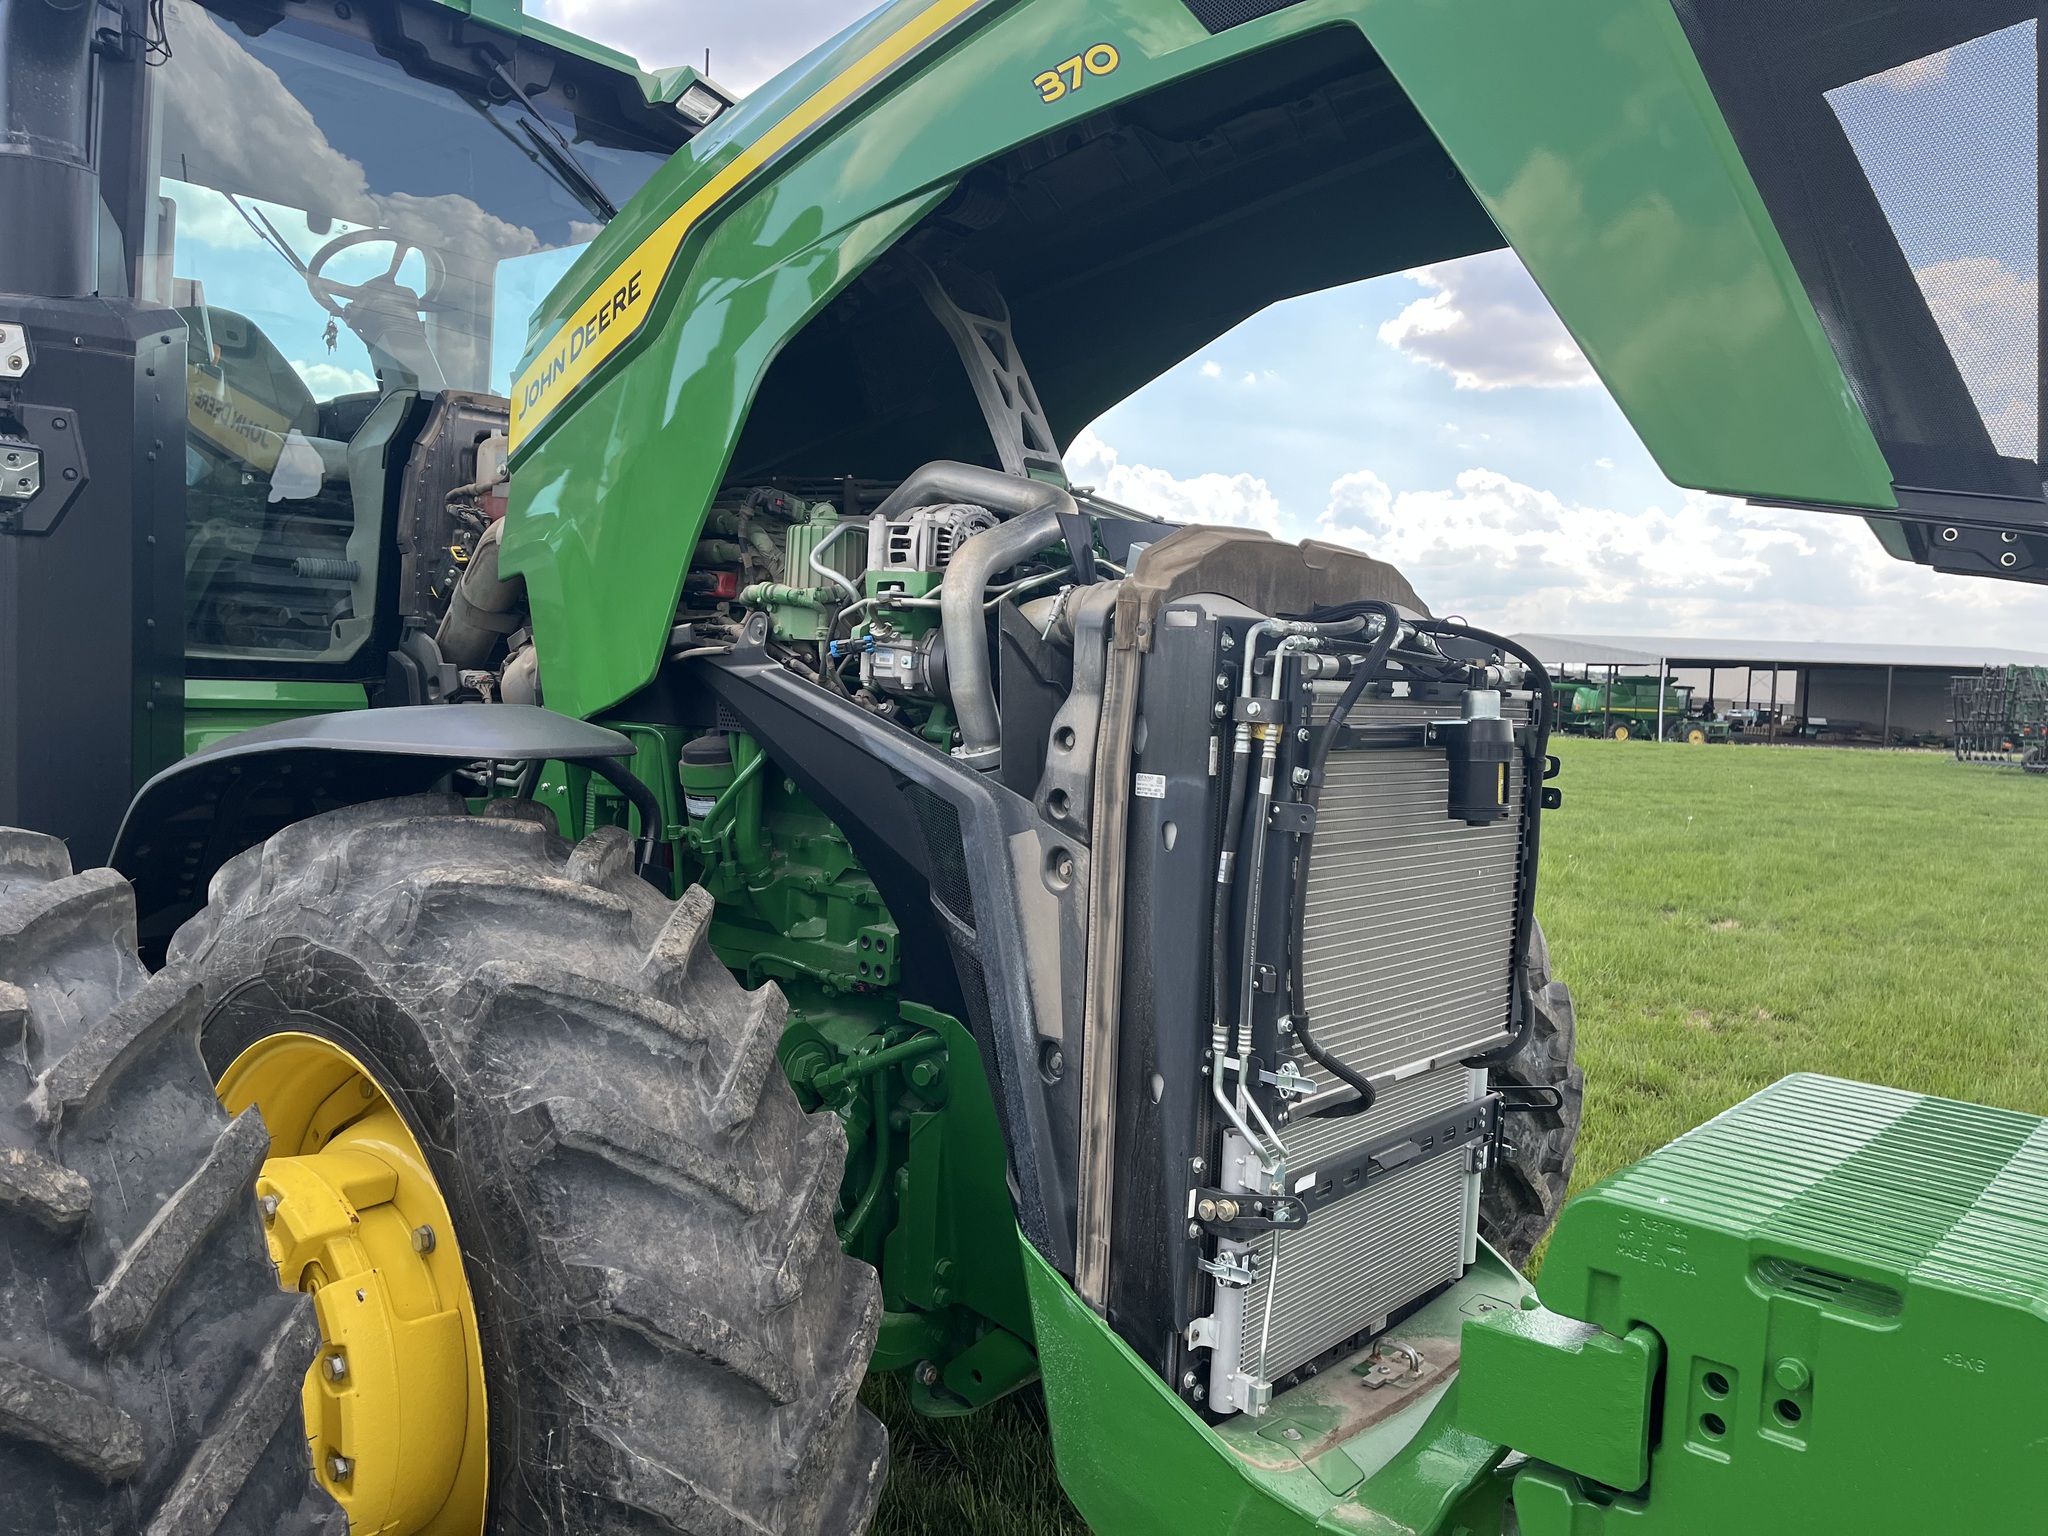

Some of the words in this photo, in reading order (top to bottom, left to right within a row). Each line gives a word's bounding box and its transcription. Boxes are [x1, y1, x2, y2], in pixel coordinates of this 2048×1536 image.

[1031, 43, 1121, 104] 370
[519, 347, 566, 421] JOHN
[570, 269, 642, 365] DEERE
